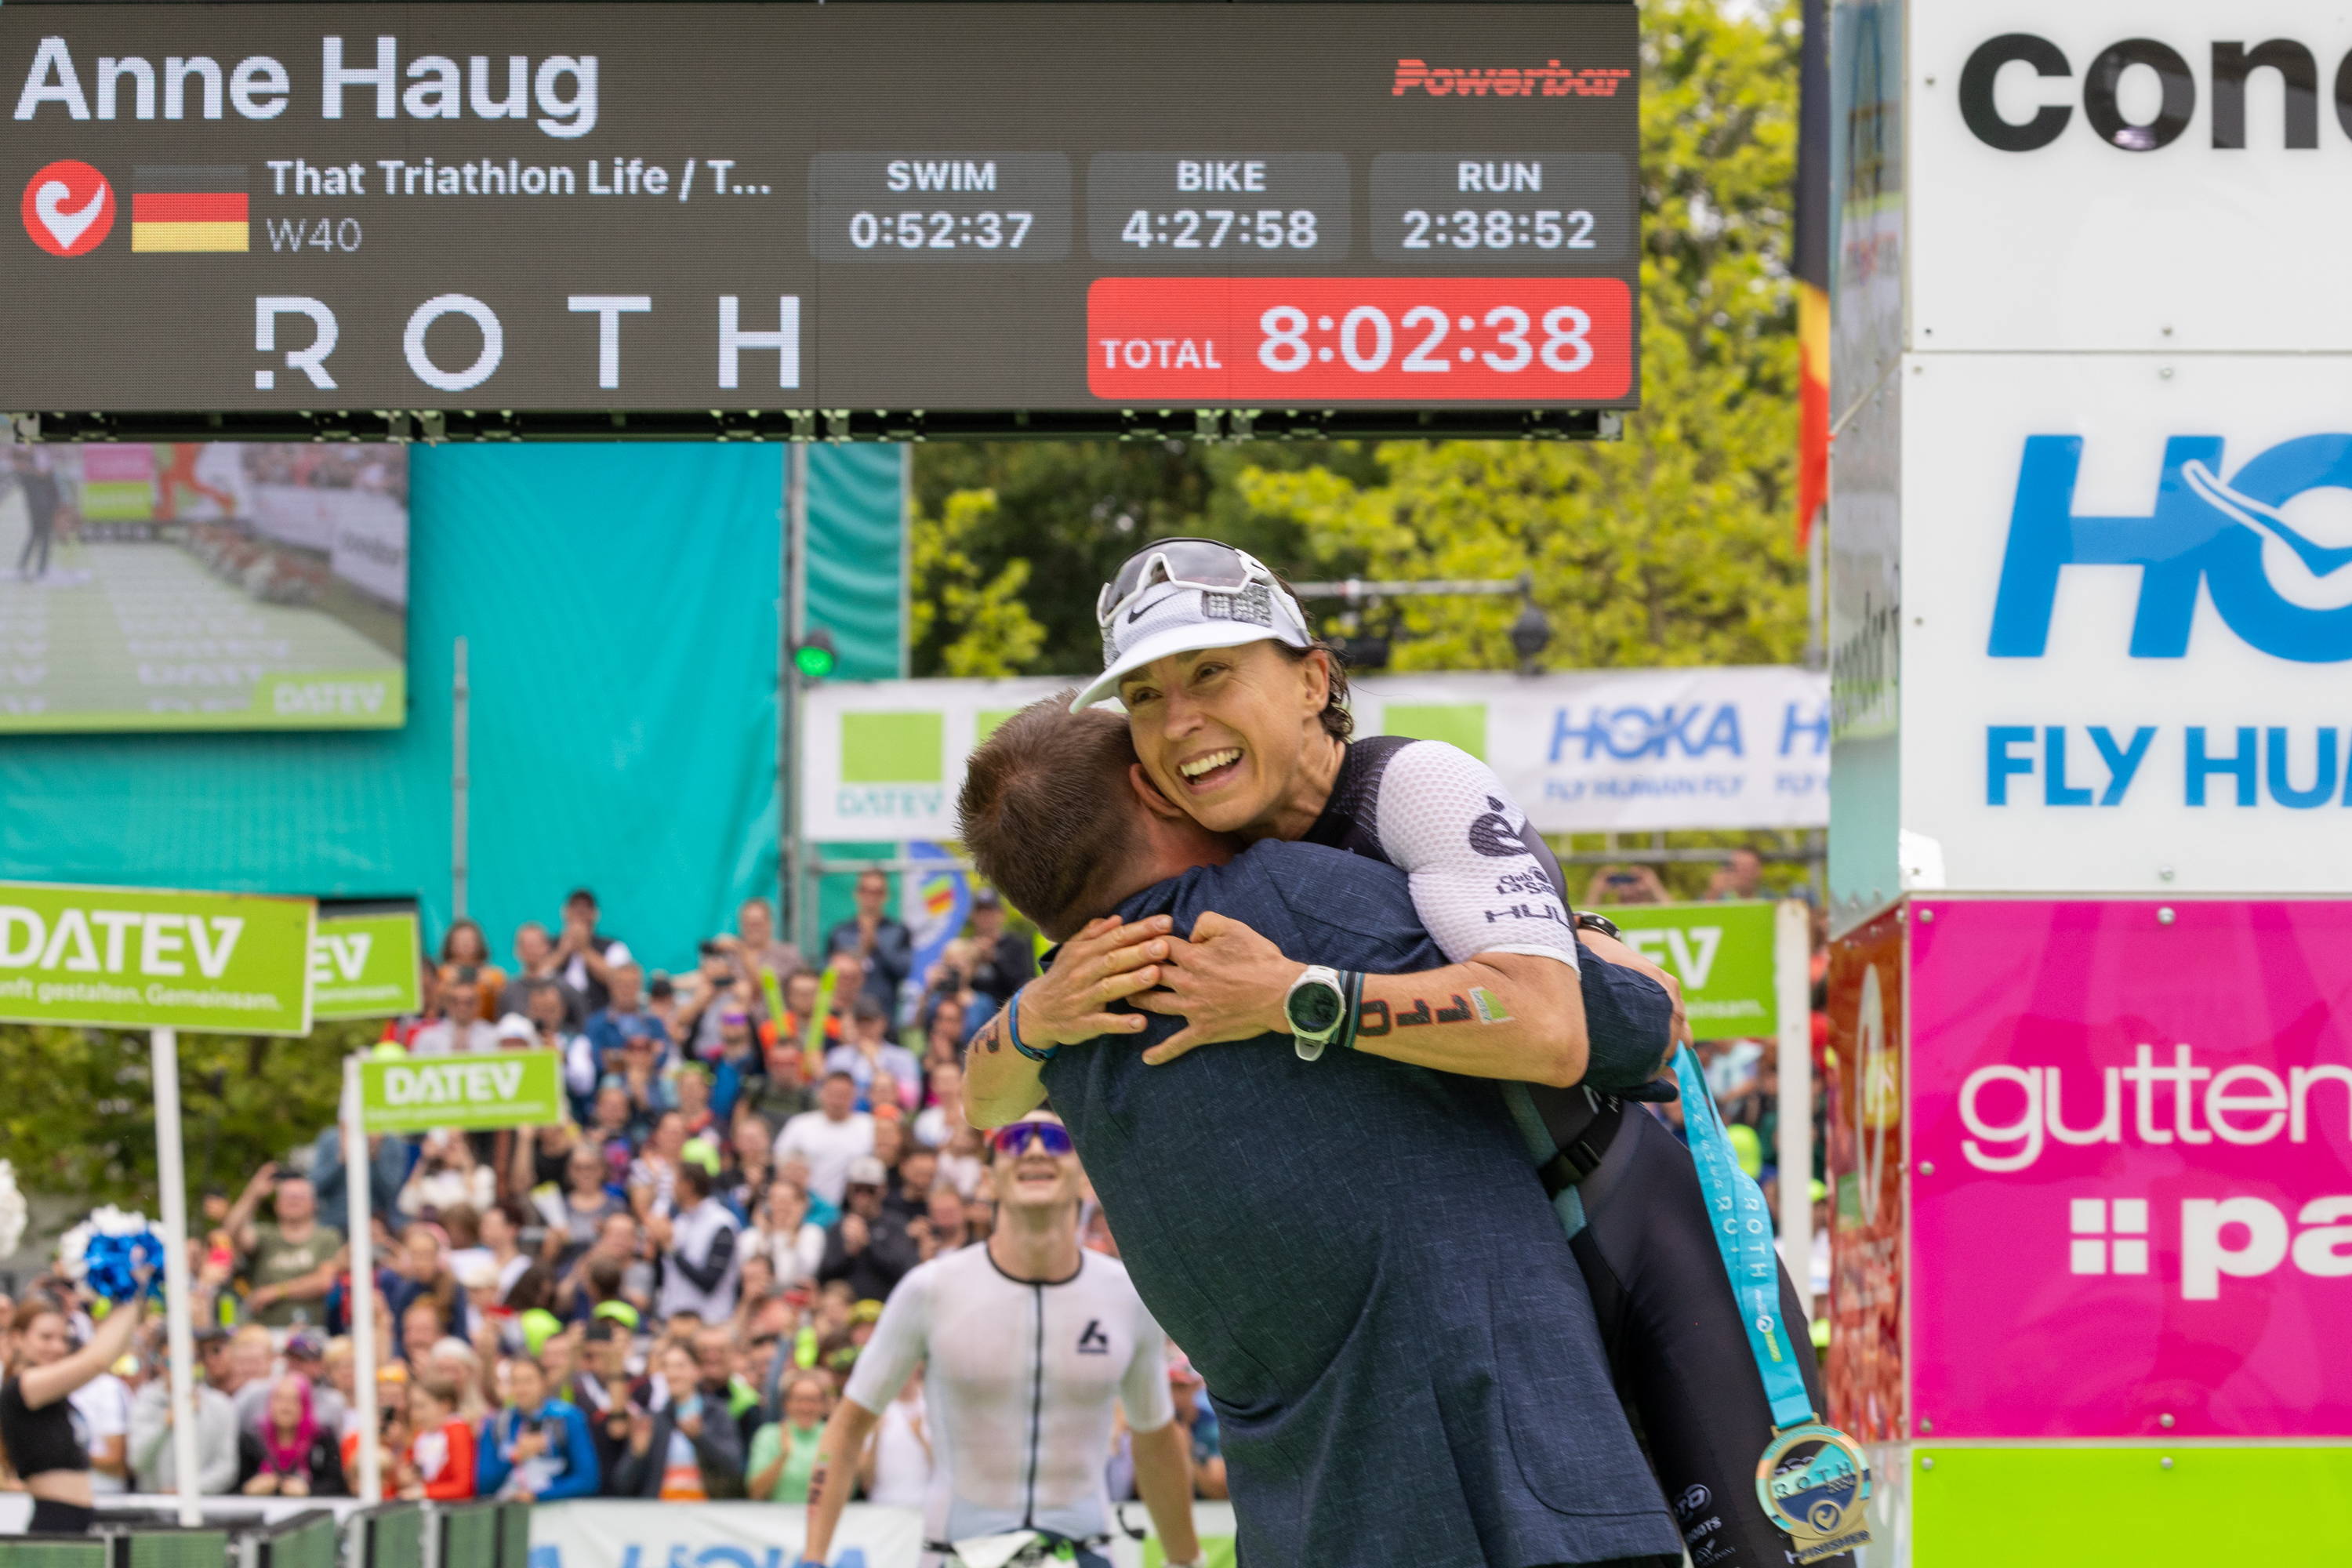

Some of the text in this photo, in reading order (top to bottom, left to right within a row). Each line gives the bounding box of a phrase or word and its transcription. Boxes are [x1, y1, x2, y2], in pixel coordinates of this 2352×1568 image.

[14, 36, 598, 138] Anne Haug
[1392, 59, 1632, 96] Powerbar
[1958, 33, 2352, 152] con
[267, 158, 365, 194] That
[377, 158, 575, 194] Triathlon
[588, 158, 669, 194] Life
[679, 158, 696, 201] /
[887, 161, 996, 191] SWIM
[1177, 161, 1266, 191] BIKE
[1457, 162, 1541, 191] RUN
[266, 217, 362, 252] W40
[849, 210, 1033, 249] 0:52:37
[1121, 210, 1318, 249] 4:27:58
[1403, 210, 1595, 249] 2:38:52
[254, 294, 800, 390] ROTH
[1100, 305, 1594, 372] TOTAL 8:02:38
[1548, 702, 1744, 762] HOKA
[1986, 726, 2352, 809] FLY HU
[0, 906, 243, 978] DATEV
[385, 1061, 523, 1105] DATEV
[1744, 1197, 1769, 1278] ROTH
[1773, 1461, 1852, 1500] ROTH
